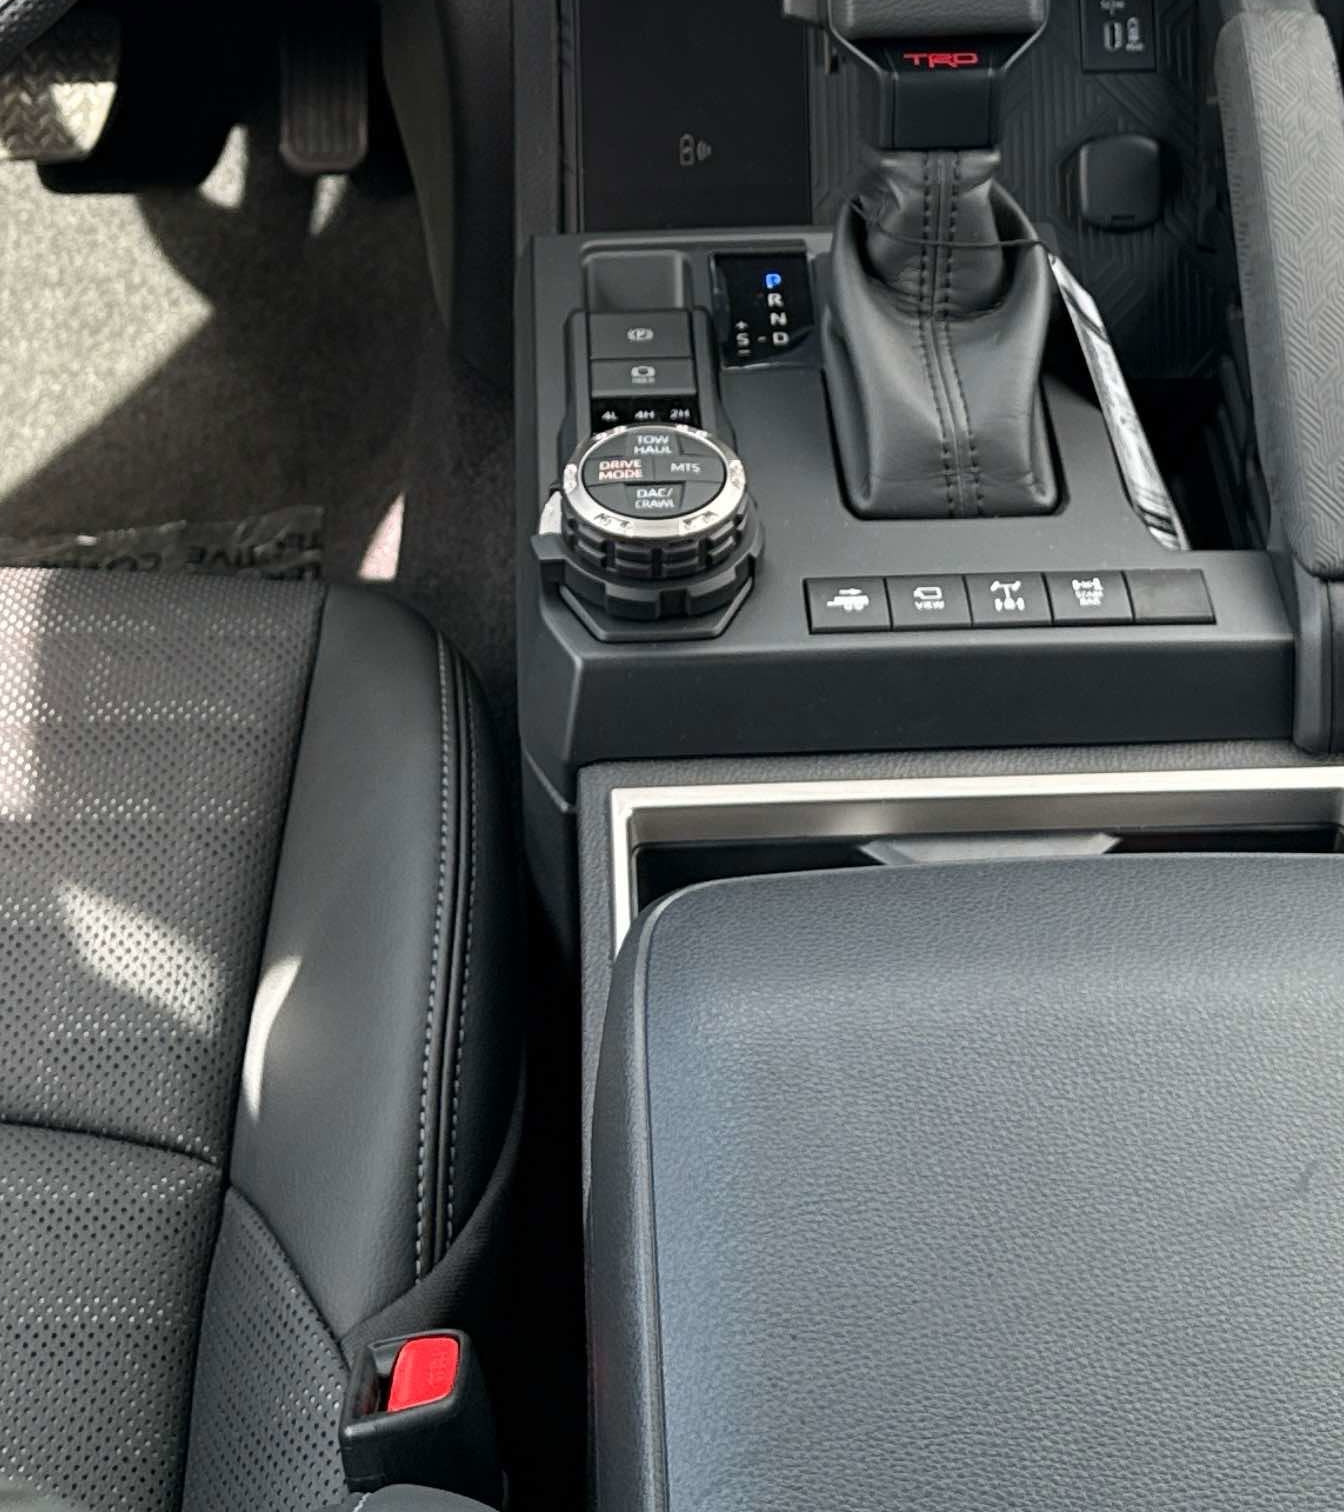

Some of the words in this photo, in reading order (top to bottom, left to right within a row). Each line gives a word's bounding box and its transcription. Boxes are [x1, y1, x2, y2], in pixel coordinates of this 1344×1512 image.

[903, 52, 979, 68] TRD
[764, 272, 782, 289] P
[767, 292, 784, 307] R
[769, 312, 787, 326] N
[736, 333, 750, 347] S
[772, 331, 789, 346] D
[601, 410, 618, 421] 4L
[634, 409, 655, 420] 4H
[669, 408, 691, 420] 2H
[636, 434, 670, 445] TOW
[633, 445, 673, 456] HAUL
[599, 459, 642, 470] DRIVE
[670, 462, 701, 473] MTS
[598, 468, 644, 480] MODE
[636, 488, 674, 500] DAC/
[634, 498, 675, 510] CRAWL
[914, 600, 945, 611] VIEW
